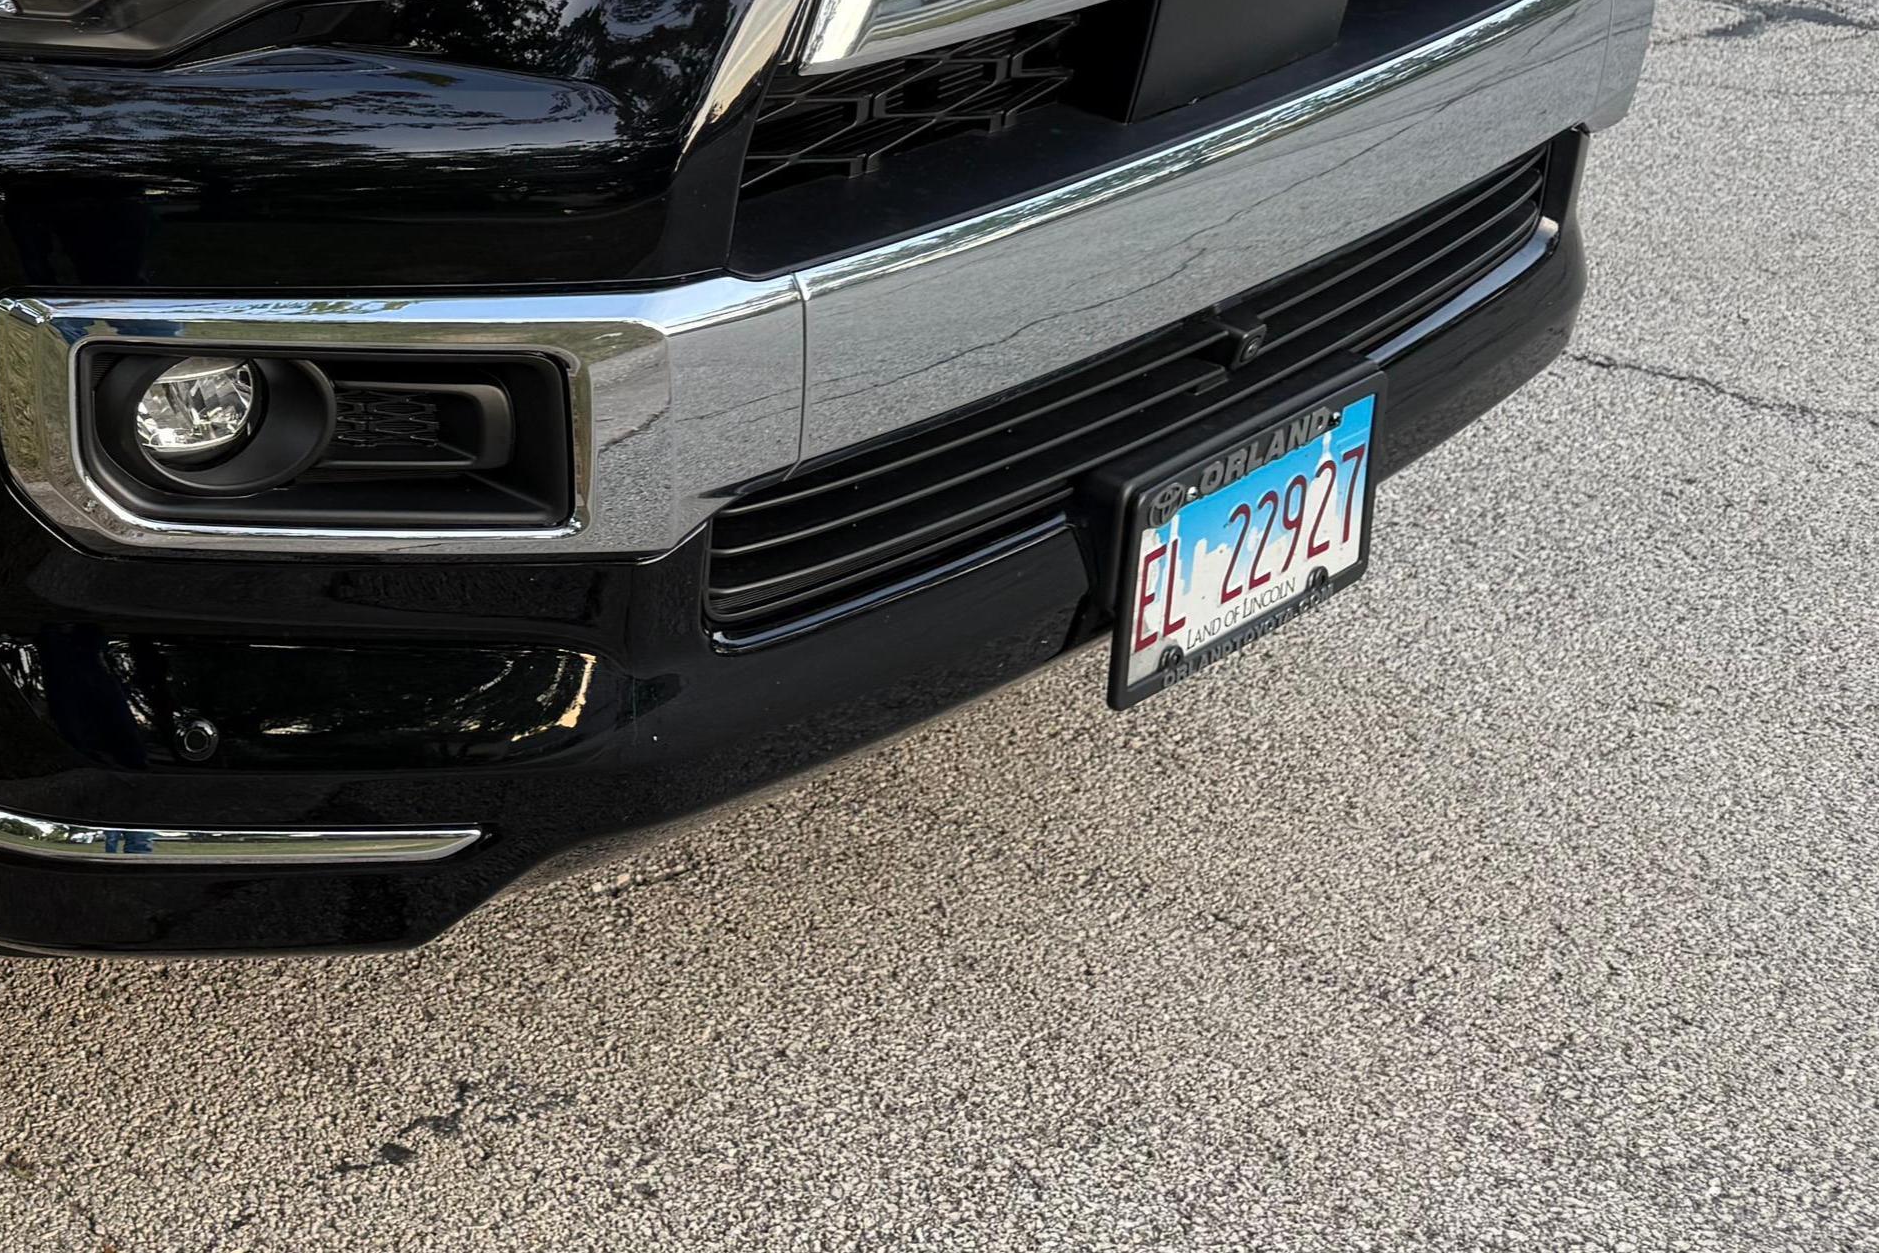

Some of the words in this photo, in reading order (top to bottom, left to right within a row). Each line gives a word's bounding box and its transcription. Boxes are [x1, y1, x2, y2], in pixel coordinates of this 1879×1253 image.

[1200, 408, 1330, 489] ORLAND
[1134, 539, 1186, 652] EL
[1221, 443, 1365, 604] 22927
[1187, 618, 1222, 649] LAND
[1224, 606, 1241, 627] OF
[1243, 577, 1296, 618] LINCOLN
